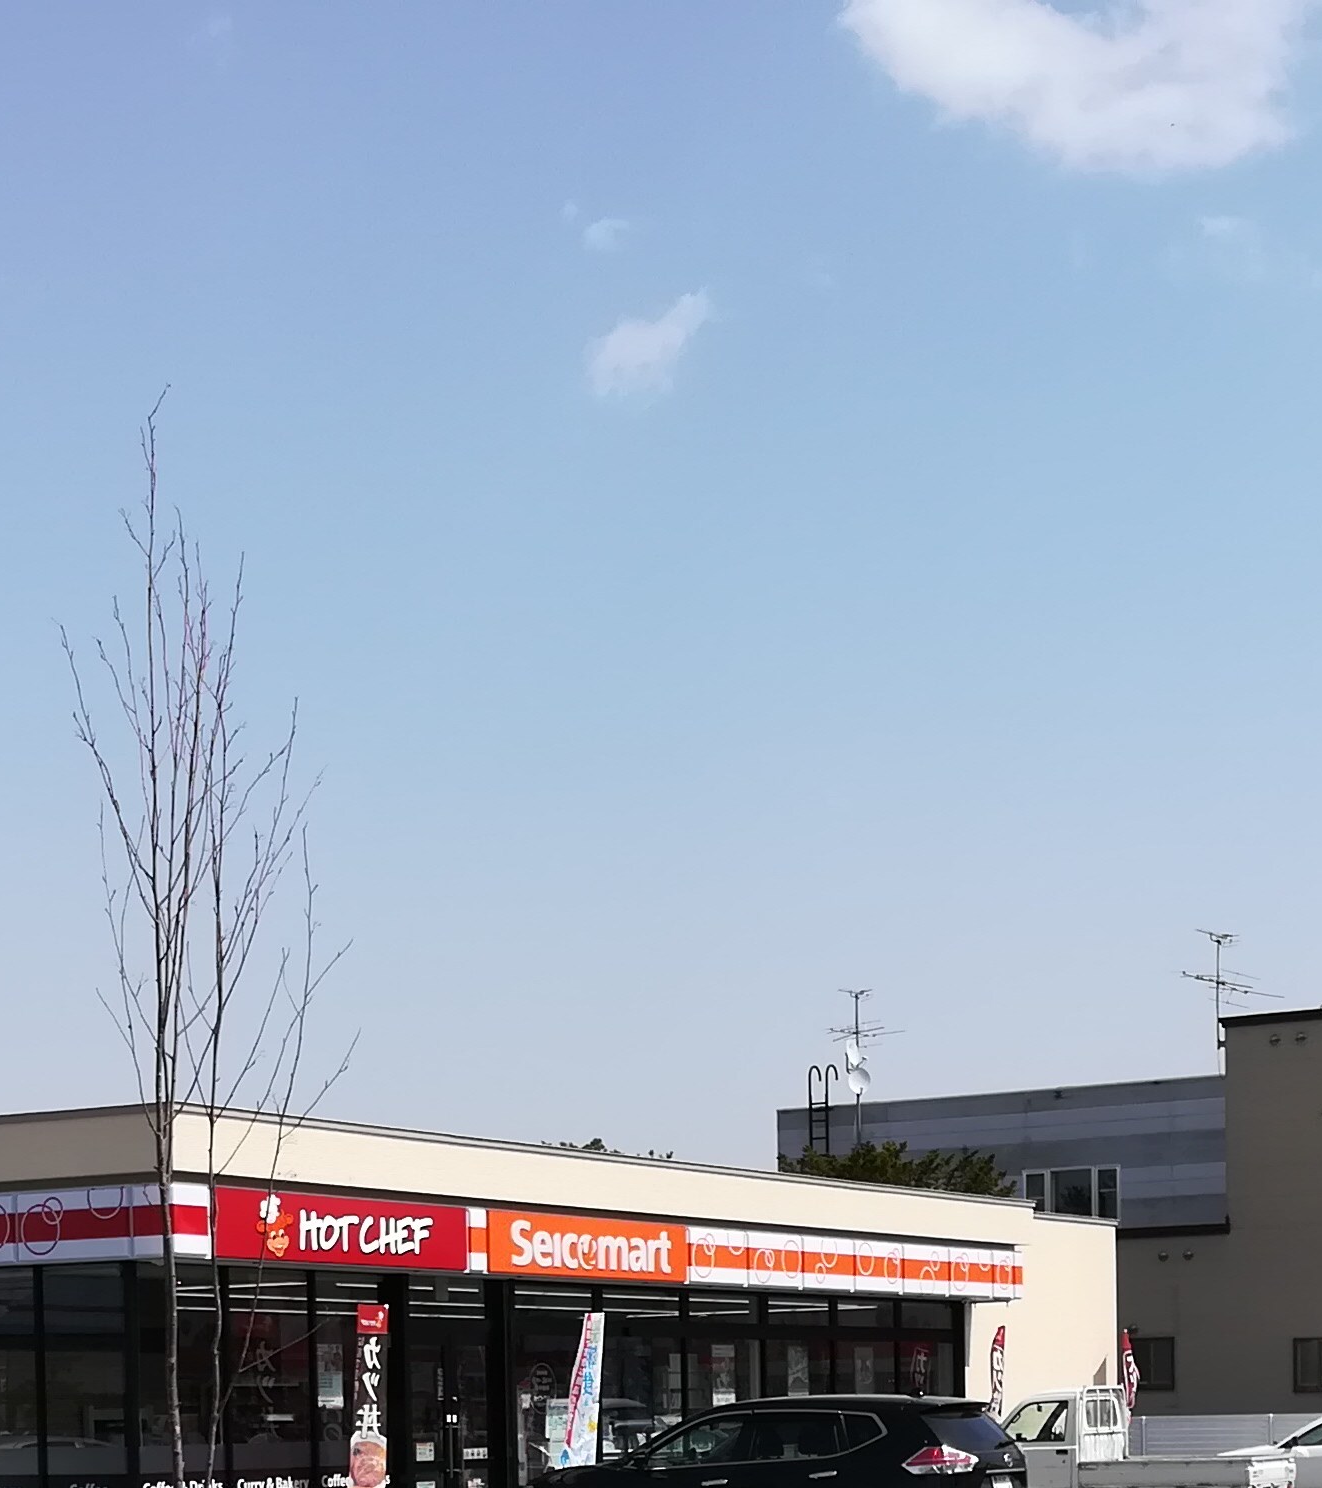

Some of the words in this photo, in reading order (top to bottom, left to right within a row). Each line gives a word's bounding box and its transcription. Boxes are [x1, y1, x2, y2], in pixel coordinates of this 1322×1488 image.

[299, 1209, 360, 1252] HOT
[359, 1215, 434, 1255] CHEF
[510, 1219, 672, 1274] Seicomart
